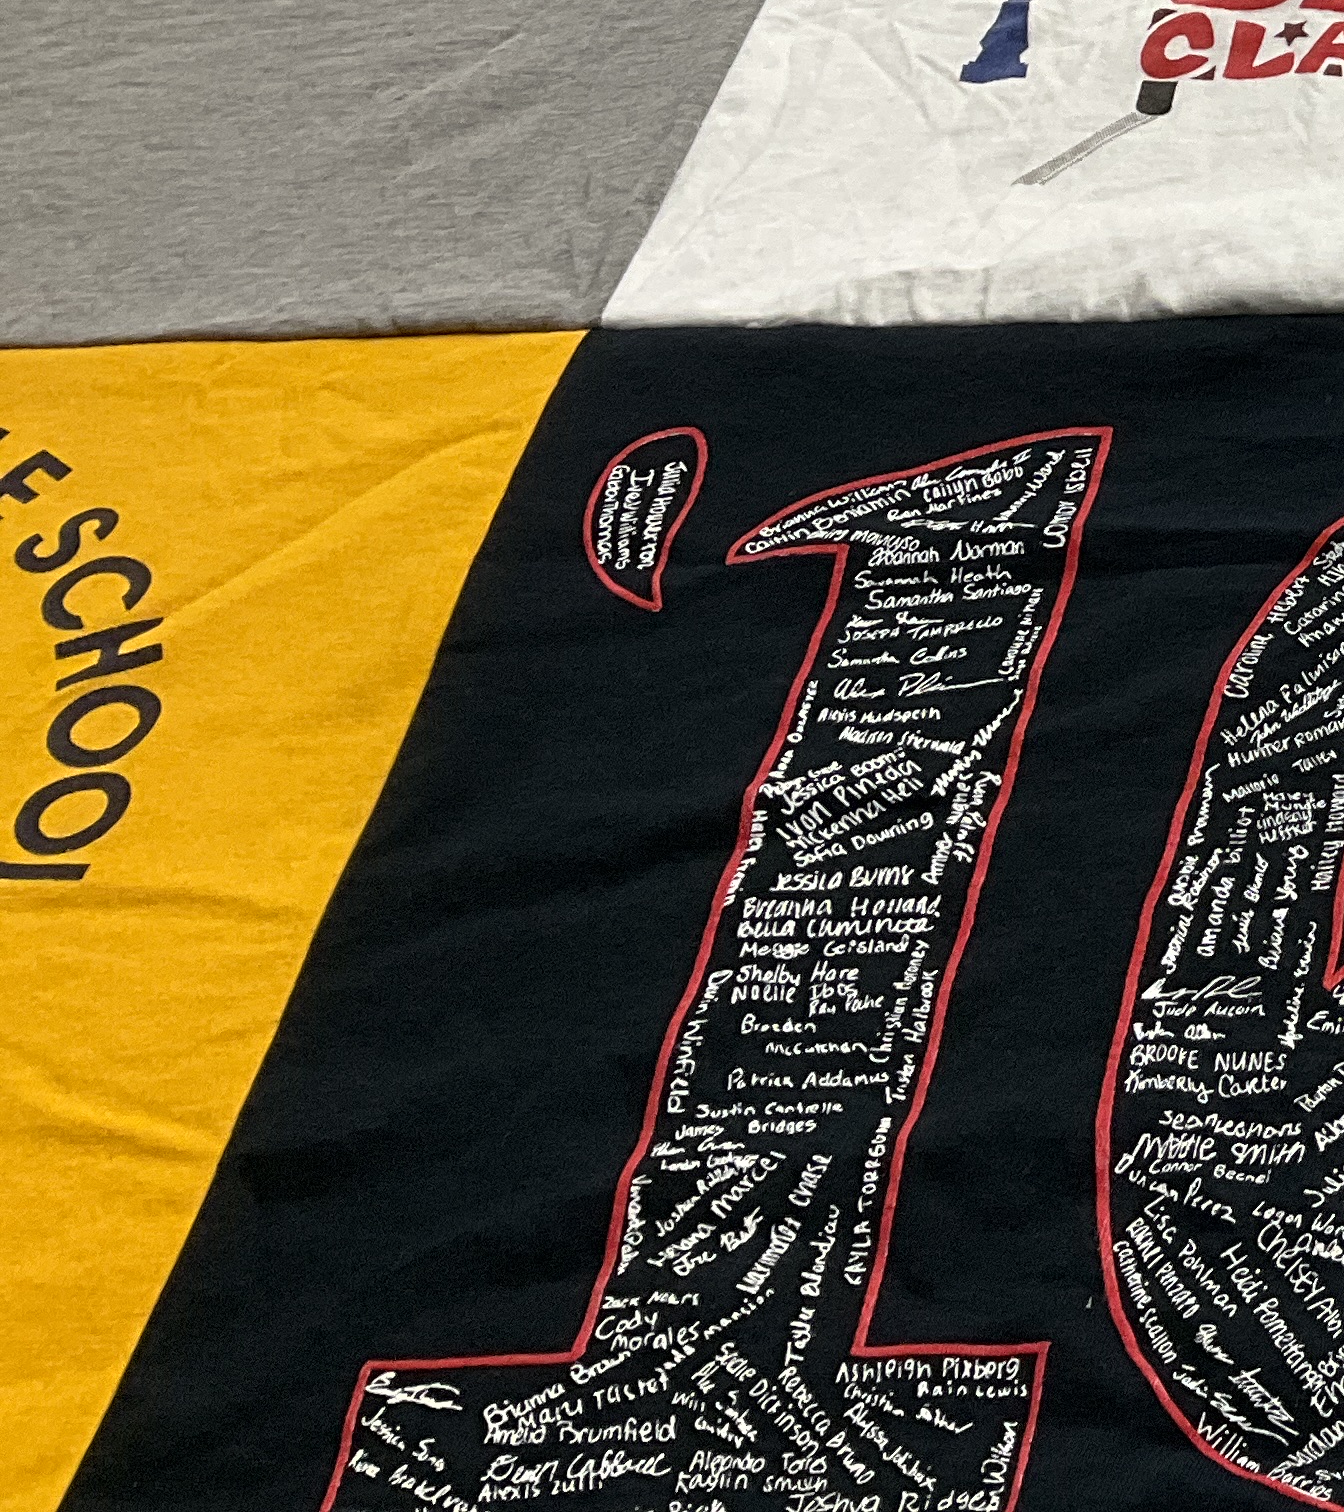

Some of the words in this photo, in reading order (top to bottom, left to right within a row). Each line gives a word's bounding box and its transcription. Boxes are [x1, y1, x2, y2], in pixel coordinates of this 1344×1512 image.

[865, 588, 954, 610] Samantha
[962, 583, 1032, 601] Santiago
[1227, 735, 1291, 769] Hunter
[851, 812, 934, 851] Downing
[735, 963, 801, 987] Shelby
[1130, 1044, 1199, 1070] BROOKE
[1214, 1050, 1288, 1073] NUNES
[696, 1103, 756, 1119] Justin
[595, 1310, 659, 1340] Cody
[556, 1414, 677, 1444] Brumfield
